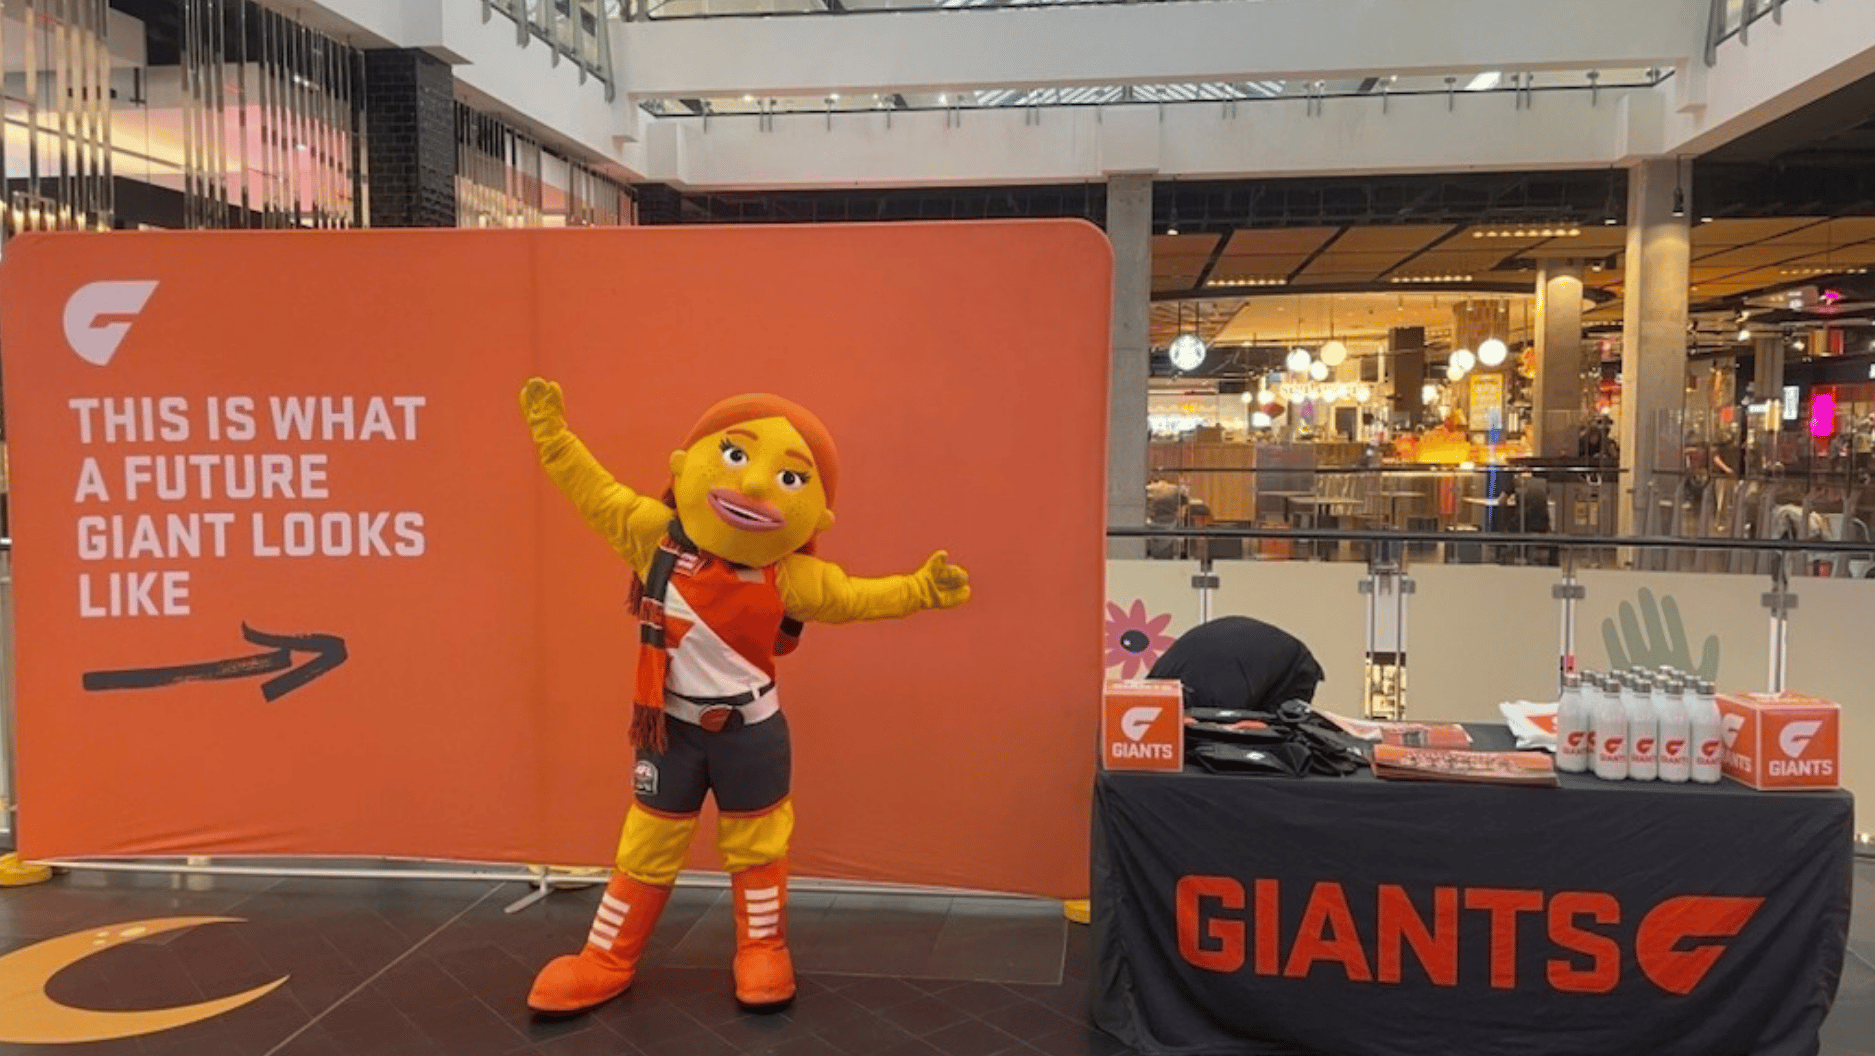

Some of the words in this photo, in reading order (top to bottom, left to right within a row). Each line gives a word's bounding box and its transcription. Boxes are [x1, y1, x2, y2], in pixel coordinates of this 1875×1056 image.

[68, 397, 190, 444] THIS
[206, 396, 256, 442] IS
[269, 396, 426, 441] WHAT
[74, 457, 110, 503] A
[124, 454, 329, 501] FUTURE
[77, 513, 236, 561] GIANT
[252, 511, 426, 558] LOOKS
[79, 571, 191, 618] LIKE
[1112, 742, 1173, 760] GIANTS
[1768, 759, 1834, 777] GIANTS
[1176, 874, 1621, 994] GIANTS
